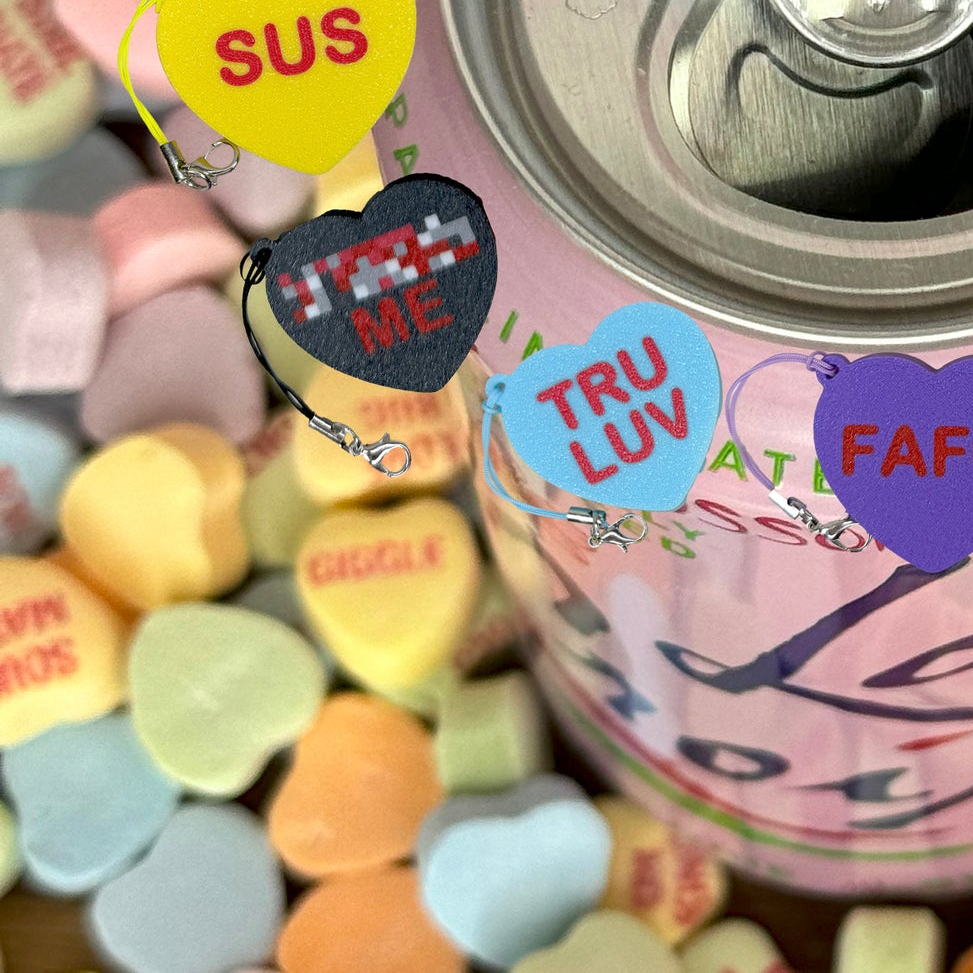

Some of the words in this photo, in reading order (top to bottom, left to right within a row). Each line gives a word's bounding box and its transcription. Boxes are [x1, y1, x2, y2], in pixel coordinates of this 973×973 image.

[215, 7, 369, 87] SUS
[350, 278, 455, 357] ME
[535, 335, 669, 431] TRU
[569, 386, 689, 486] LUV
